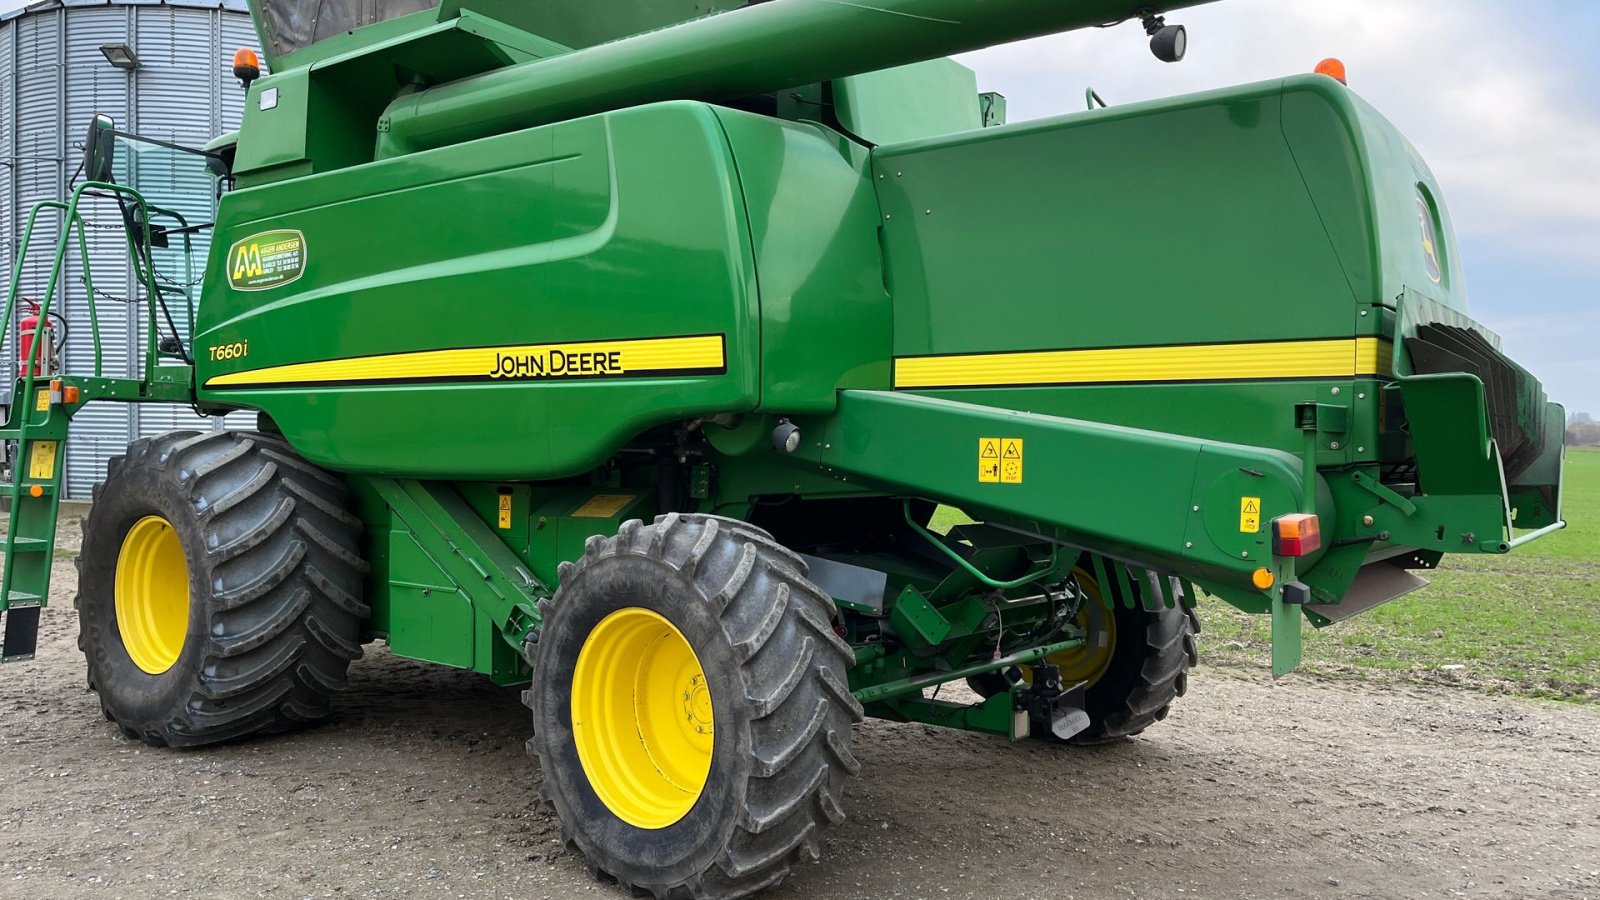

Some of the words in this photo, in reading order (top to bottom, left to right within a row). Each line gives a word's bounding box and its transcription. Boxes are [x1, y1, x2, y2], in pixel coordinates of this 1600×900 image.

[209, 338, 248, 361] T660i
[490, 352, 544, 375] JOHN
[549, 350, 622, 373] DEERE
